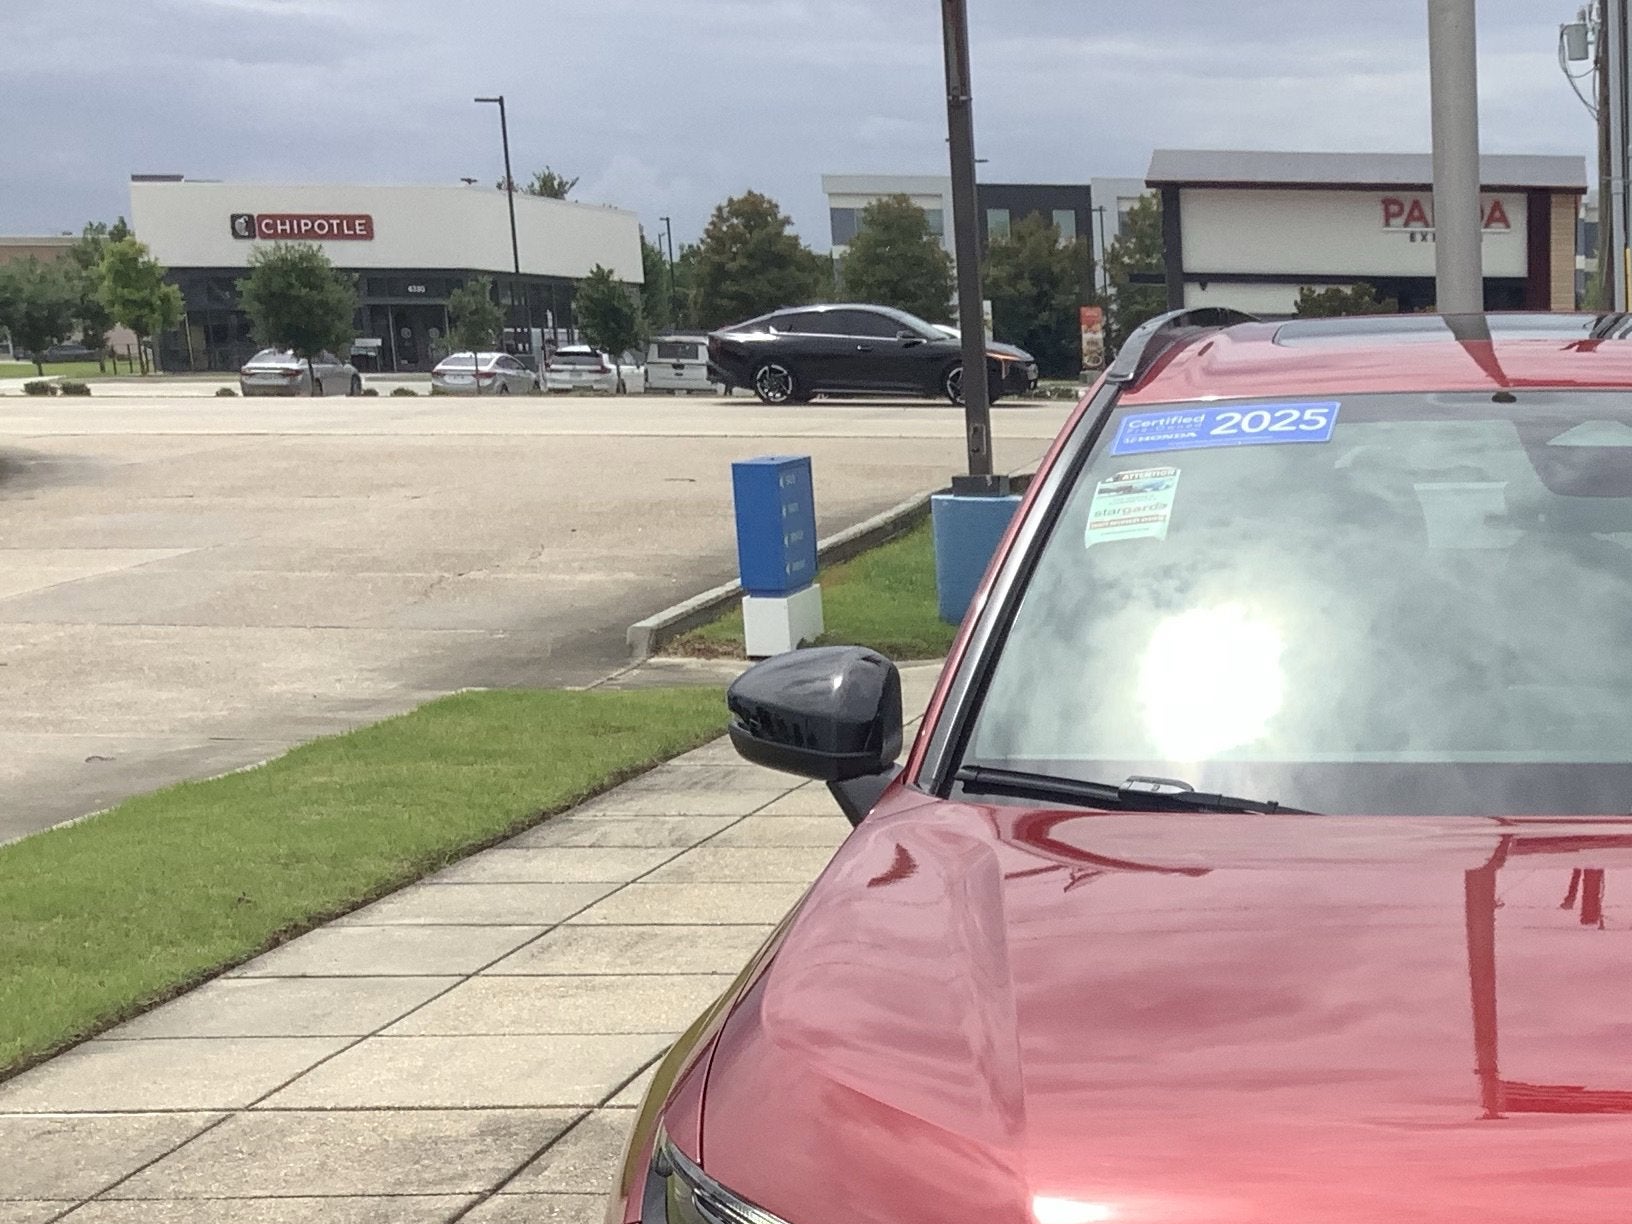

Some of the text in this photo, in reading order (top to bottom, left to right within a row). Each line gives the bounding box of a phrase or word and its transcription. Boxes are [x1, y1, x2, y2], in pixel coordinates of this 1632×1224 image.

[1381, 197, 1511, 229] PAA
[261, 218, 368, 235] CHIPOTLE
[1129, 414, 1205, 428] Certified
[1210, 407, 1330, 436] 2025
[1121, 468, 1178, 481] ATTENTION
